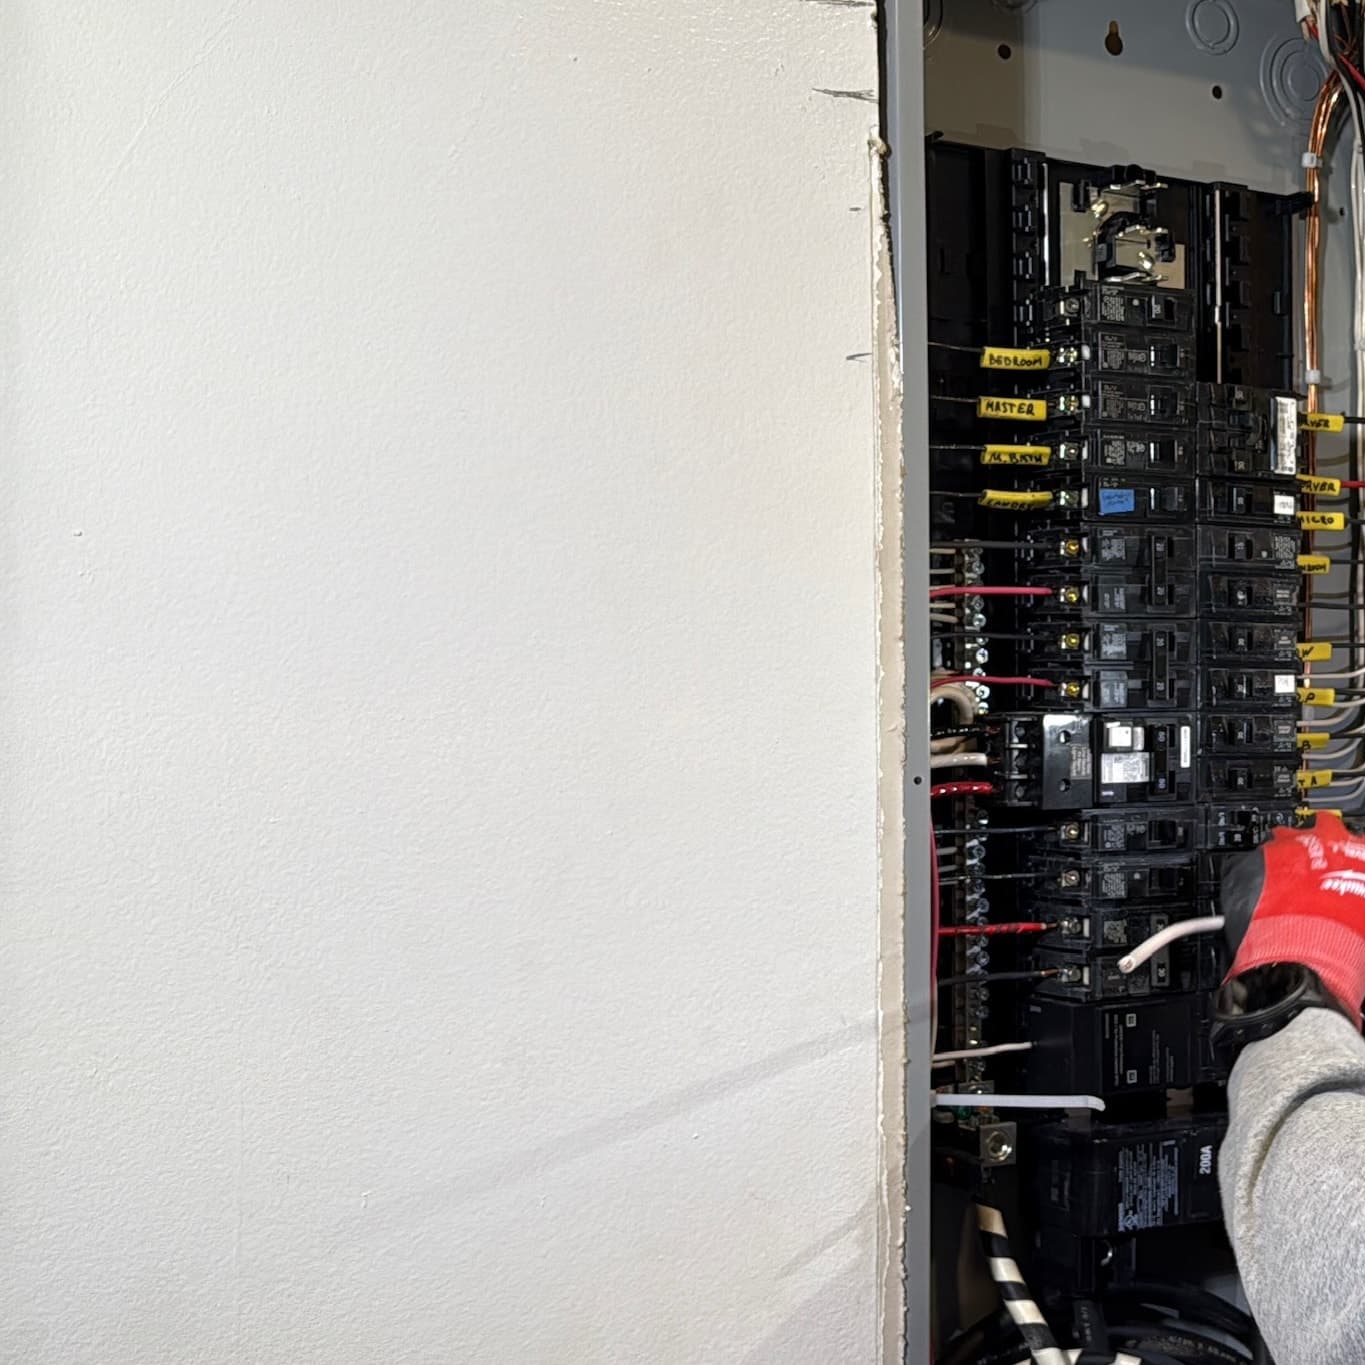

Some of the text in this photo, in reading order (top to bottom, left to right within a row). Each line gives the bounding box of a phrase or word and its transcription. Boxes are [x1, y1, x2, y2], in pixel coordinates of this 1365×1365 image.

[989, 353, 1042, 366] BEDROOM
[985, 401, 1035, 416] MASTER
[1199, 1145, 1213, 1175] 200A
